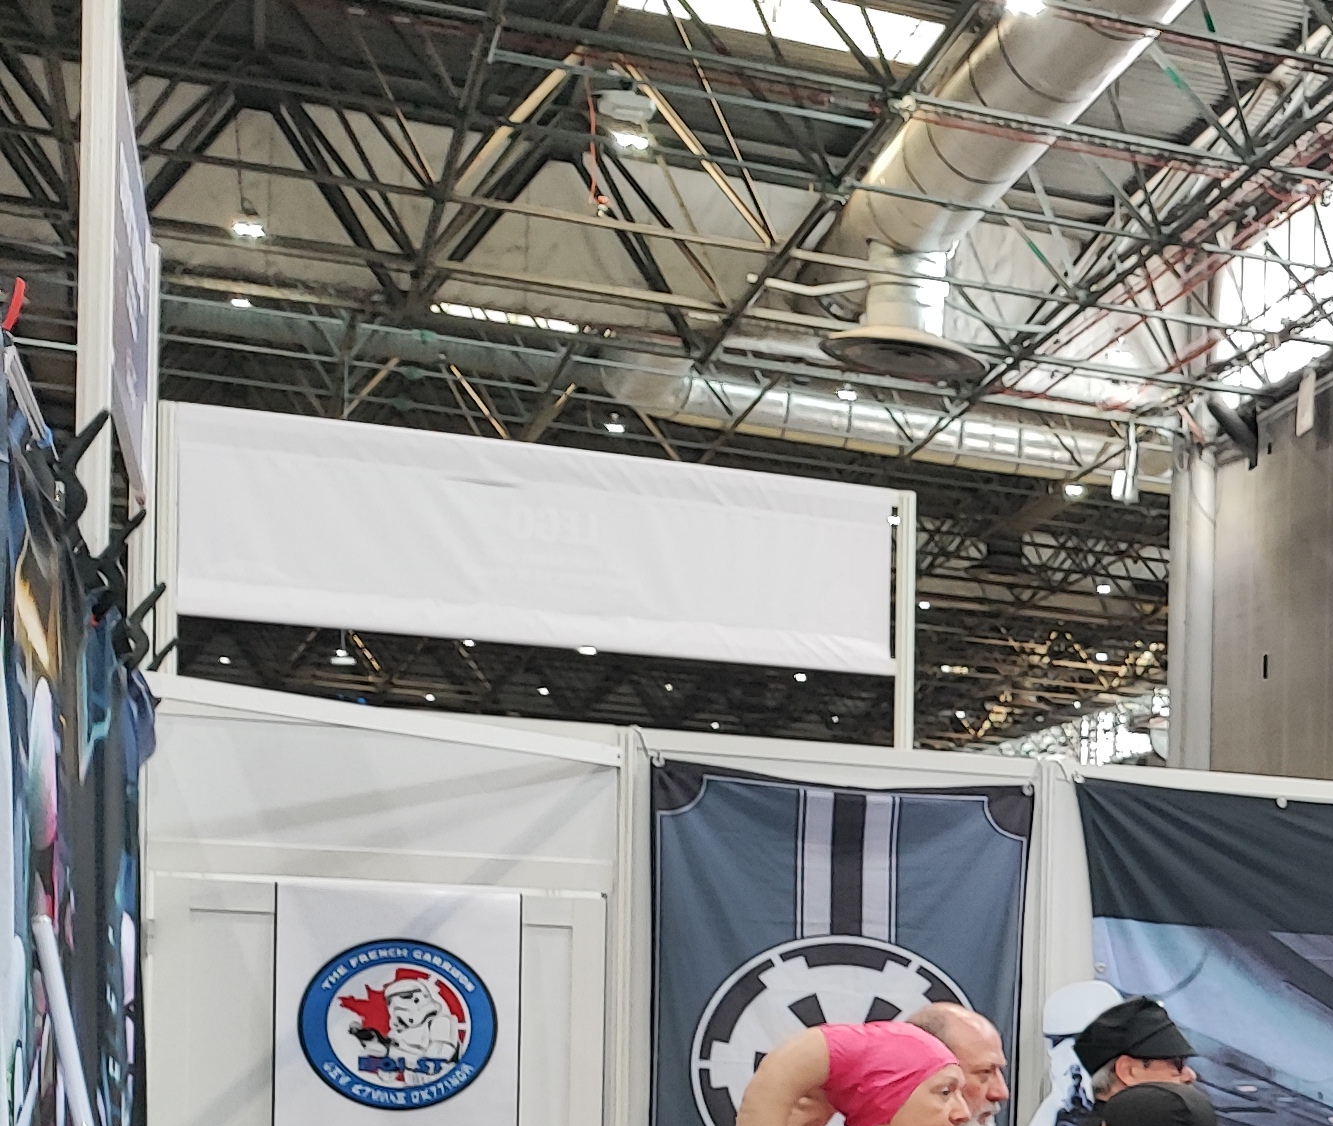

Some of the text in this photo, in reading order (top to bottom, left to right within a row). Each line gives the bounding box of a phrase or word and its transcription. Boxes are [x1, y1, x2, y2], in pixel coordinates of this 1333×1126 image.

[321, 948, 476, 993] THE FRENCH GARRISON
